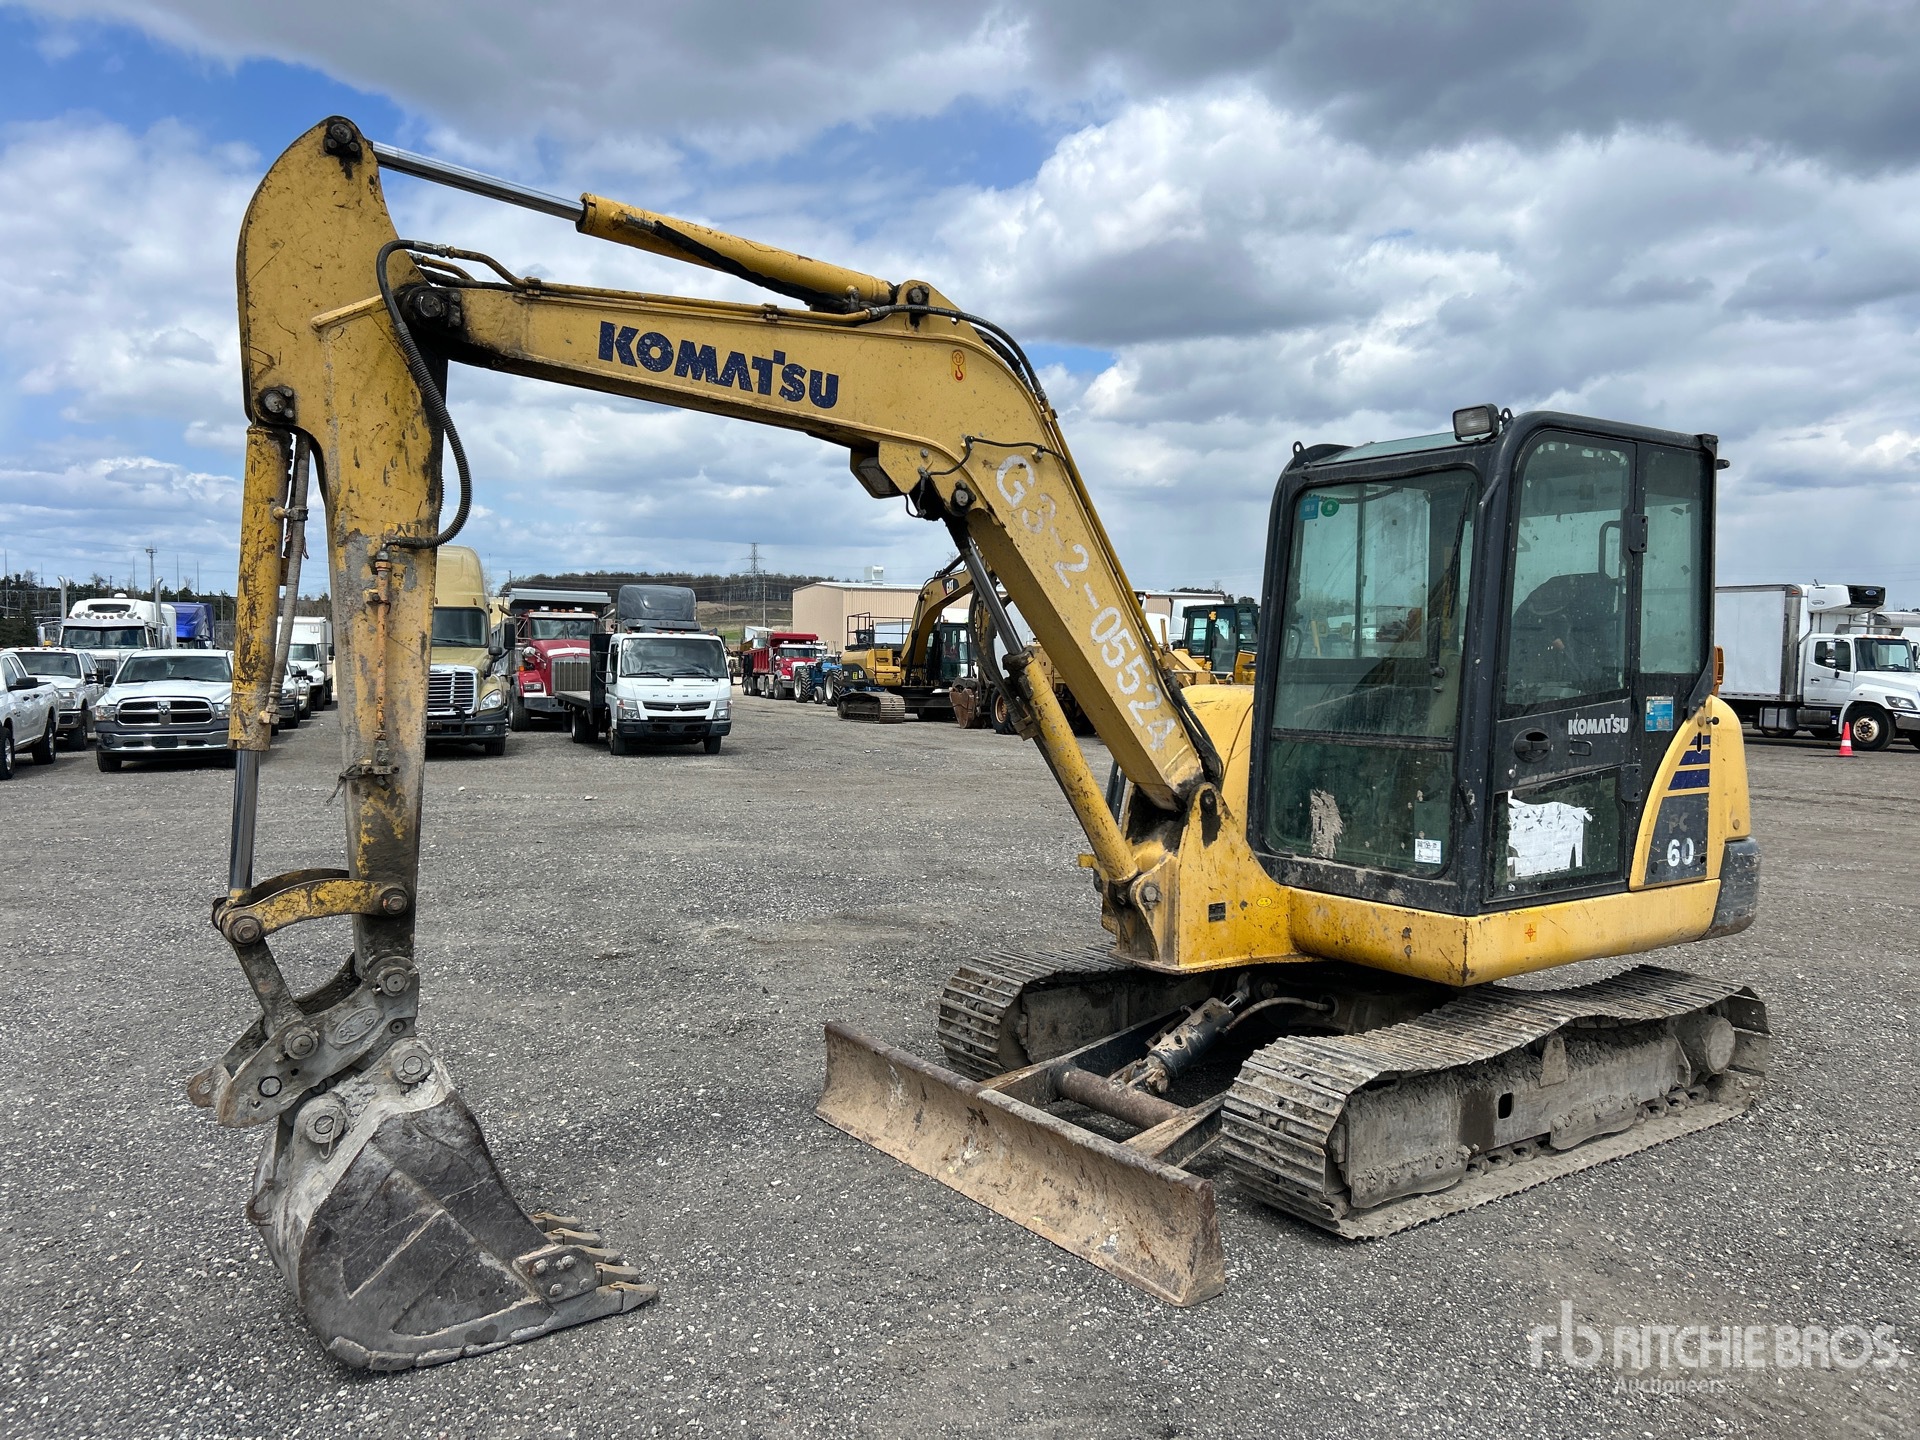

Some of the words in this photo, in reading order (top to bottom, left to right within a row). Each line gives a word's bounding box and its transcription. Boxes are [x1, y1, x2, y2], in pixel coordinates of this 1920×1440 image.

[598, 320, 839, 409] KOMATSU
[1568, 714, 1629, 735] KOMATSU
[1667, 837, 1695, 867] 60
